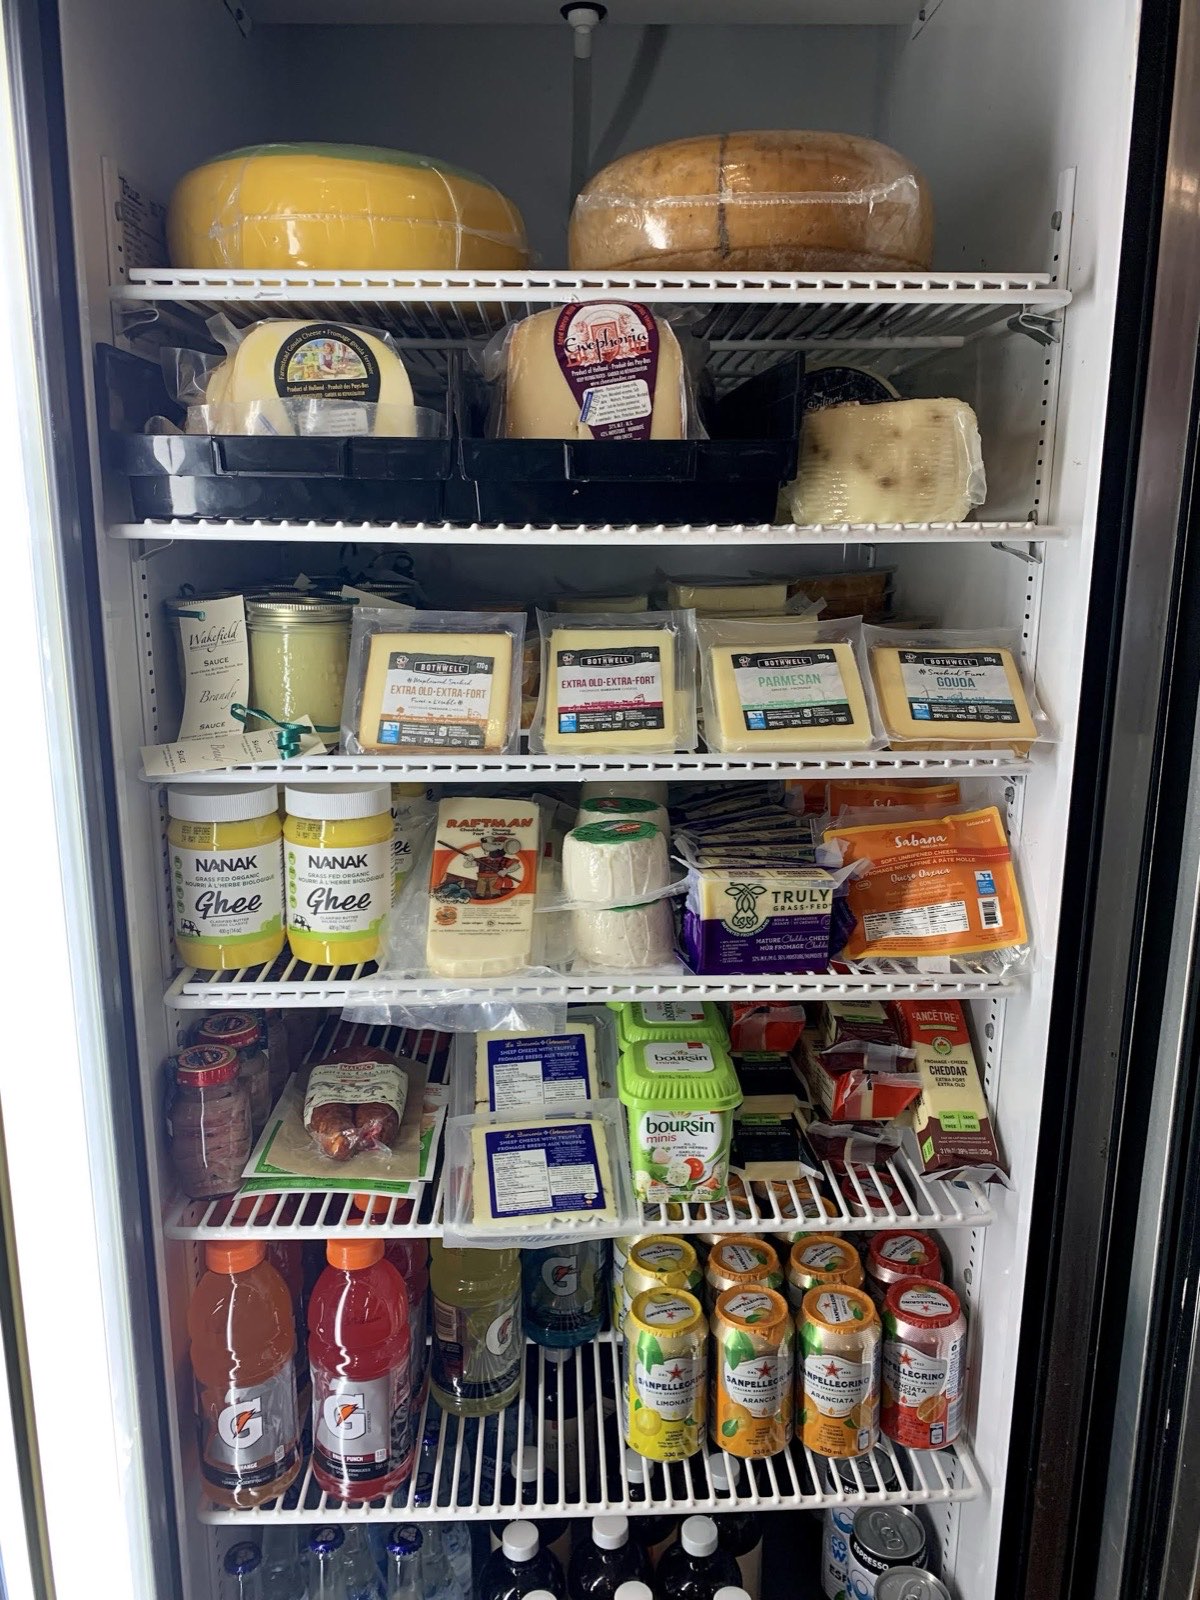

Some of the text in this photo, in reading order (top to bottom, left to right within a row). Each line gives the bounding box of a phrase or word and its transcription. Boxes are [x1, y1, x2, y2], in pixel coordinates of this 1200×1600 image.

[302, 330, 322, 339] Cheese
[326, 329, 352, 343] Fromage
[189, 620, 242, 652] Wakefield
[204, 656, 230, 666] SAUCE
[587, 657, 629, 665] BOTHWELL
[764, 658, 806, 667] BOTHWELL
[930, 658, 972, 666] BOTHWELL
[420, 664, 464, 673] BOTHWELL
[562, 680, 587, 689] EXTRA
[758, 674, 822, 688] PARMESAN
[936, 677, 976, 688] GOUDA
[200, 678, 240, 710] Brandy
[390, 684, 416, 695] EXTRA
[200, 722, 226, 730] SAUCE
[446, 818, 534, 828] RAFTMAN
[894, 834, 947, 848] Sabana
[308, 854, 368, 870] NANAK
[898, 852, 933, 862] UNRIPENED
[934, 848, 958, 856] CHEESE
[195, 854, 258, 872] NANAK
[864, 866, 894, 876] FROMAGE
[894, 864, 909, 872] NON
[232, 872, 260, 882] ORGANIC
[342, 871, 370, 879] ORGANIC
[306, 887, 372, 916] Ghee
[772, 889, 830, 904] TRULY
[195, 890, 262, 920] Ghee
[654, 1054, 708, 1062] boursin
[929, 1066, 968, 1076] CHEDDAR
[646, 1116, 716, 1136] boursin
[646, 1134, 677, 1144] minis
[542, 1255, 578, 1296] G
[729, 1296, 769, 1312] SANPELLEGRINO
[810, 1390, 854, 1404] ARANCIATA
[218, 1396, 264, 1450] G
[324, 1393, 366, 1440] G
[854, 1542, 889, 1571] ESPRESSO
